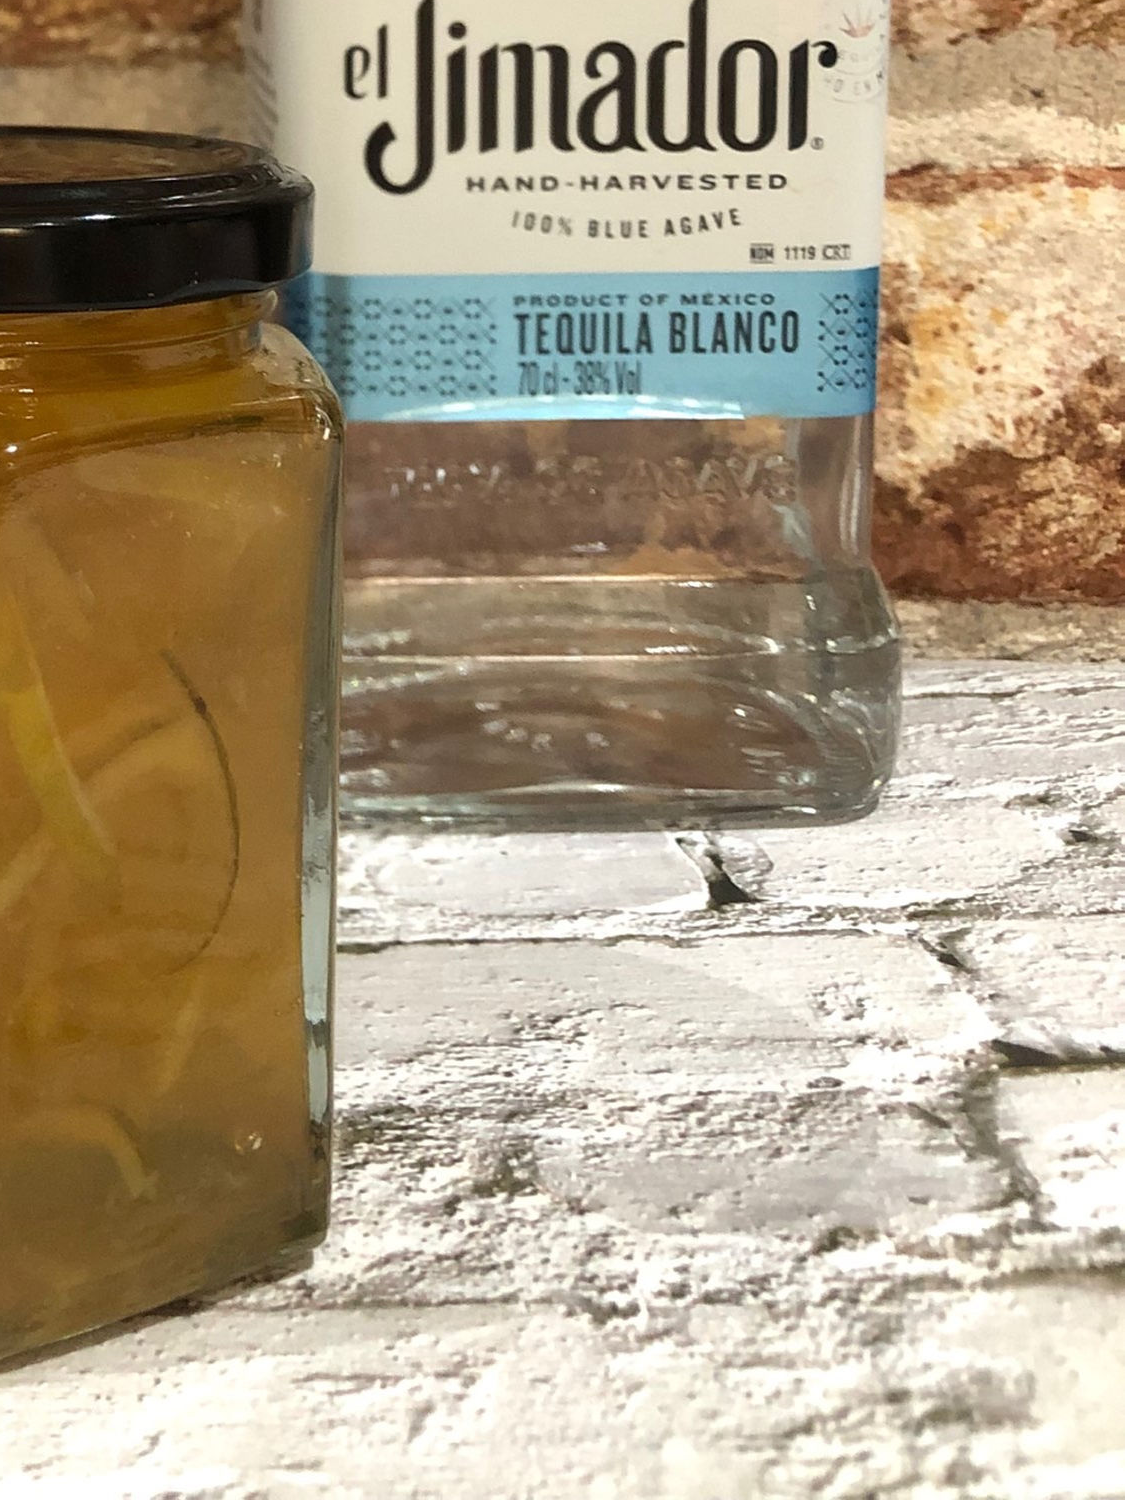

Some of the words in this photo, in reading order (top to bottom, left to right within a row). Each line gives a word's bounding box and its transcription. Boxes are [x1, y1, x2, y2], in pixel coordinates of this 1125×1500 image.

[343, 24, 388, 100] el
[467, 174, 789, 192] HAND-HARVESTED
[512, 210, 574, 237] 100%
[587, 219, 649, 239] BLUE
[663, 208, 743, 237] AGAVE
[784, 245, 817, 261] 1119
[822, 244, 851, 261] CRT
[513, 294, 627, 307] PRODUCT
[639, 294, 668, 306] OF
[514, 312, 653, 355] TEQUILA
[668, 310, 799, 354] BLANCO
